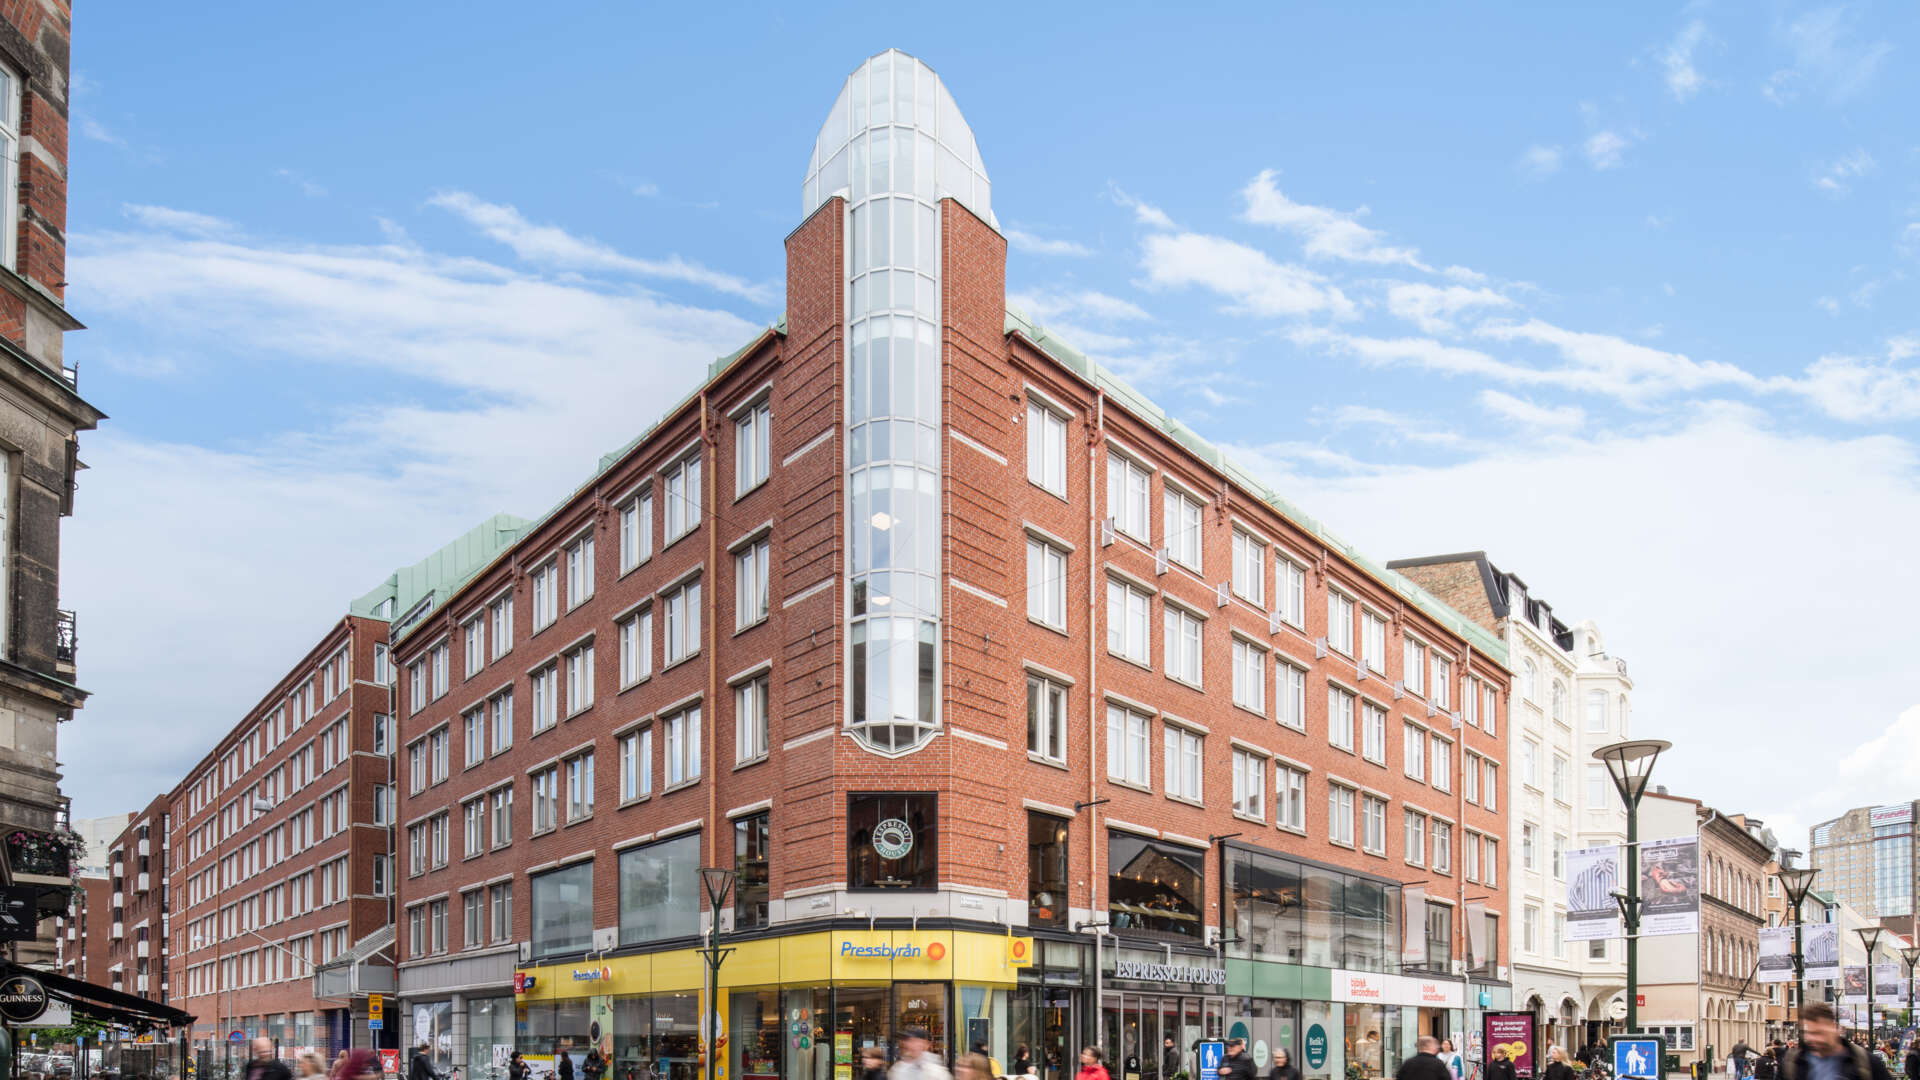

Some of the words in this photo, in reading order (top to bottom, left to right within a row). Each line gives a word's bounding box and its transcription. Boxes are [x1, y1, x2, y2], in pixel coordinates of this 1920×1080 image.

[874, 821, 911, 837] ESPRESSO
[840, 941, 921, 960] Pressbyrån
[1116, 960, 1181, 982] ESPRESSO
[1183, 967, 1226, 984] HOUSE
[0, 994, 43, 1003] GUINNESS
